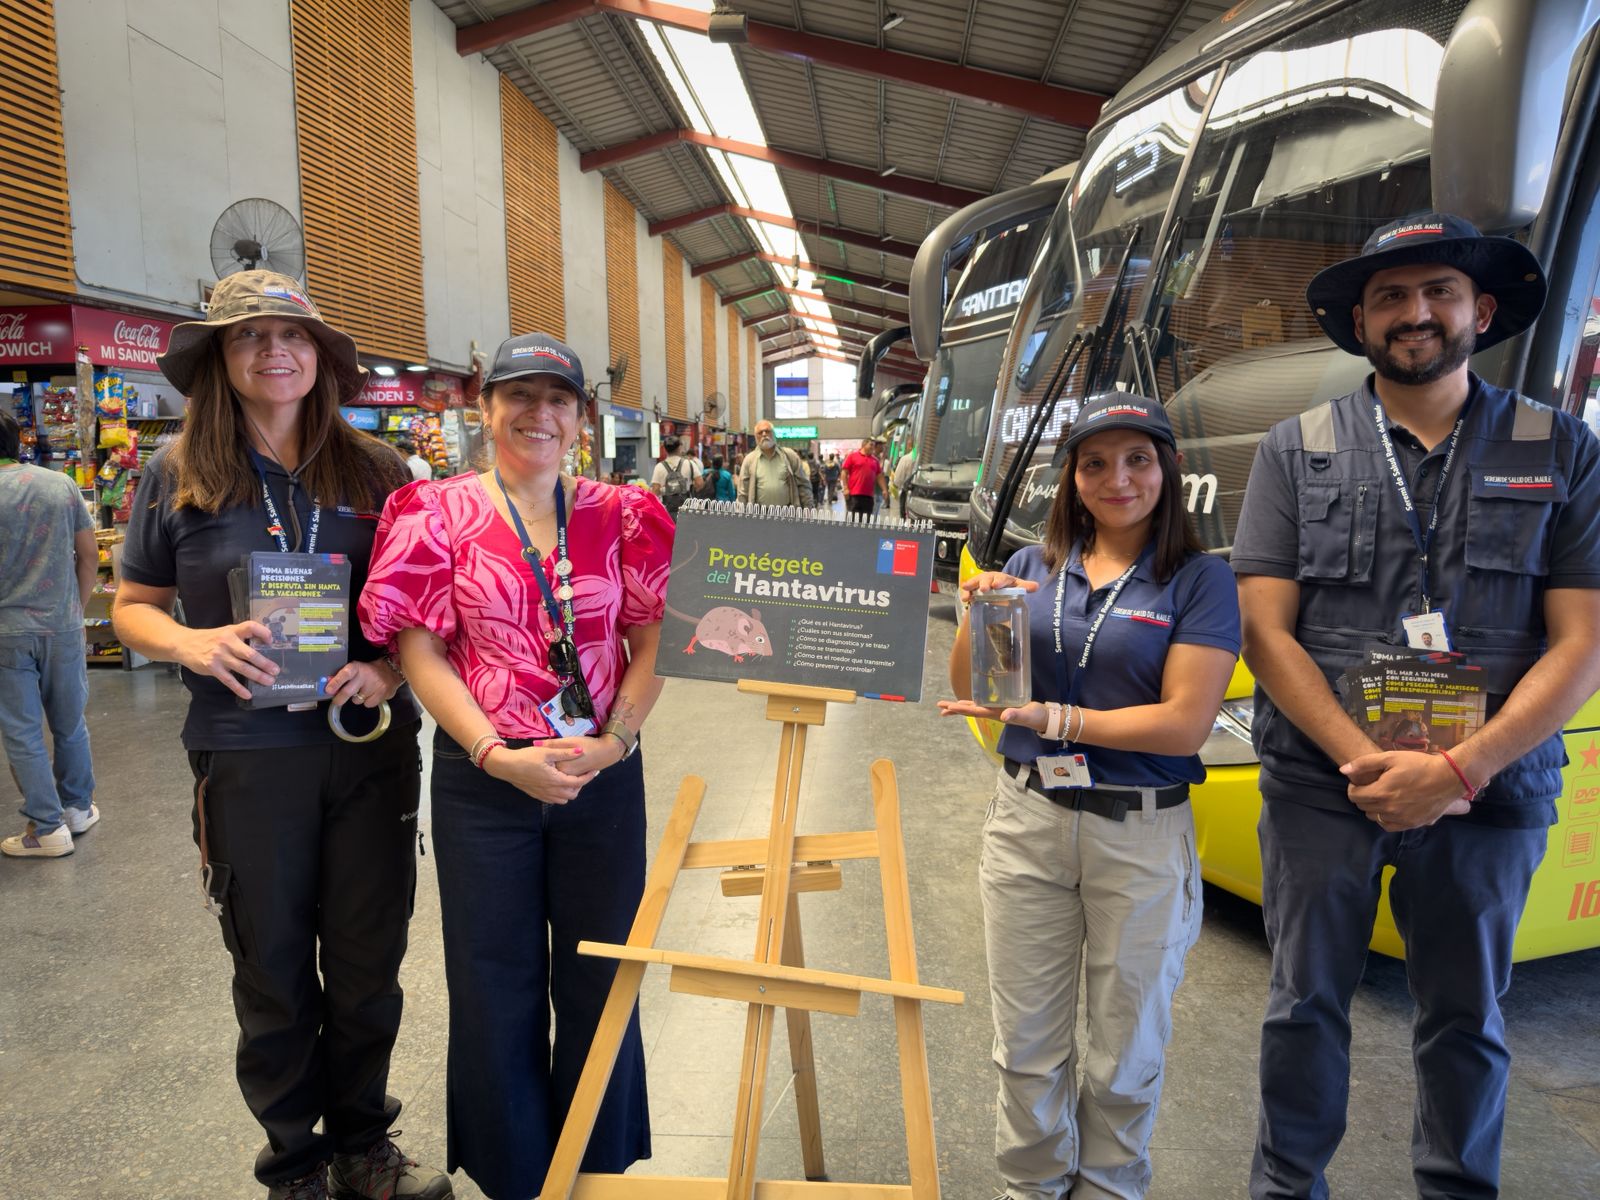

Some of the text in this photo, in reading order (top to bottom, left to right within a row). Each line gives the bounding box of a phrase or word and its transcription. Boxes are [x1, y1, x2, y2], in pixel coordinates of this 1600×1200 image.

[1398, 225, 1413, 233] SALUD
[0, 313, 28, 340] ola
[114, 320, 160, 349] Coca-Cola
[101, 345, 115, 360] MI
[534, 345, 549, 353] SALUD
[406, 391, 415, 402] 3
[1377, 422, 1385, 433] del
[1382, 434, 1394, 458] Región
[1386, 457, 1400, 477] Salud
[1396, 477, 1404, 486] de
[1398, 488, 1413, 512] Seremi
[264, 499, 278, 518] Salud
[312, 503, 320, 523] Salud
[273, 517, 282, 527] de
[311, 523, 319, 533] de
[558, 527, 566, 548] Maule
[708, 547, 824, 577] Protégete
[284, 567, 312, 575] BUENAS
[706, 570, 891, 607] del Hantavirus
[1054, 600, 1062, 617] Salud
[1133, 608, 1147, 616] SALUD
[1156, 612, 1171, 622] MAULE
[829, 620, 863, 630] Hantavirus?
[1053, 617, 1060, 627] de
[1079, 642, 1092, 668] Seremi
[1087, 632, 1095, 642] de
[1091, 613, 1105, 632] Salud
[1101, 591, 1116, 613] Región
[1114, 579, 1124, 590] del
[873, 642, 890, 650] trata?
[1053, 628, 1062, 653] Seremi
[825, 646, 856, 654] transmite?
[815, 662, 839, 670] prevenir
[846, 665, 876, 673] controlar?
[851, 657, 863, 665] que
[864, 658, 895, 667] transmite?
